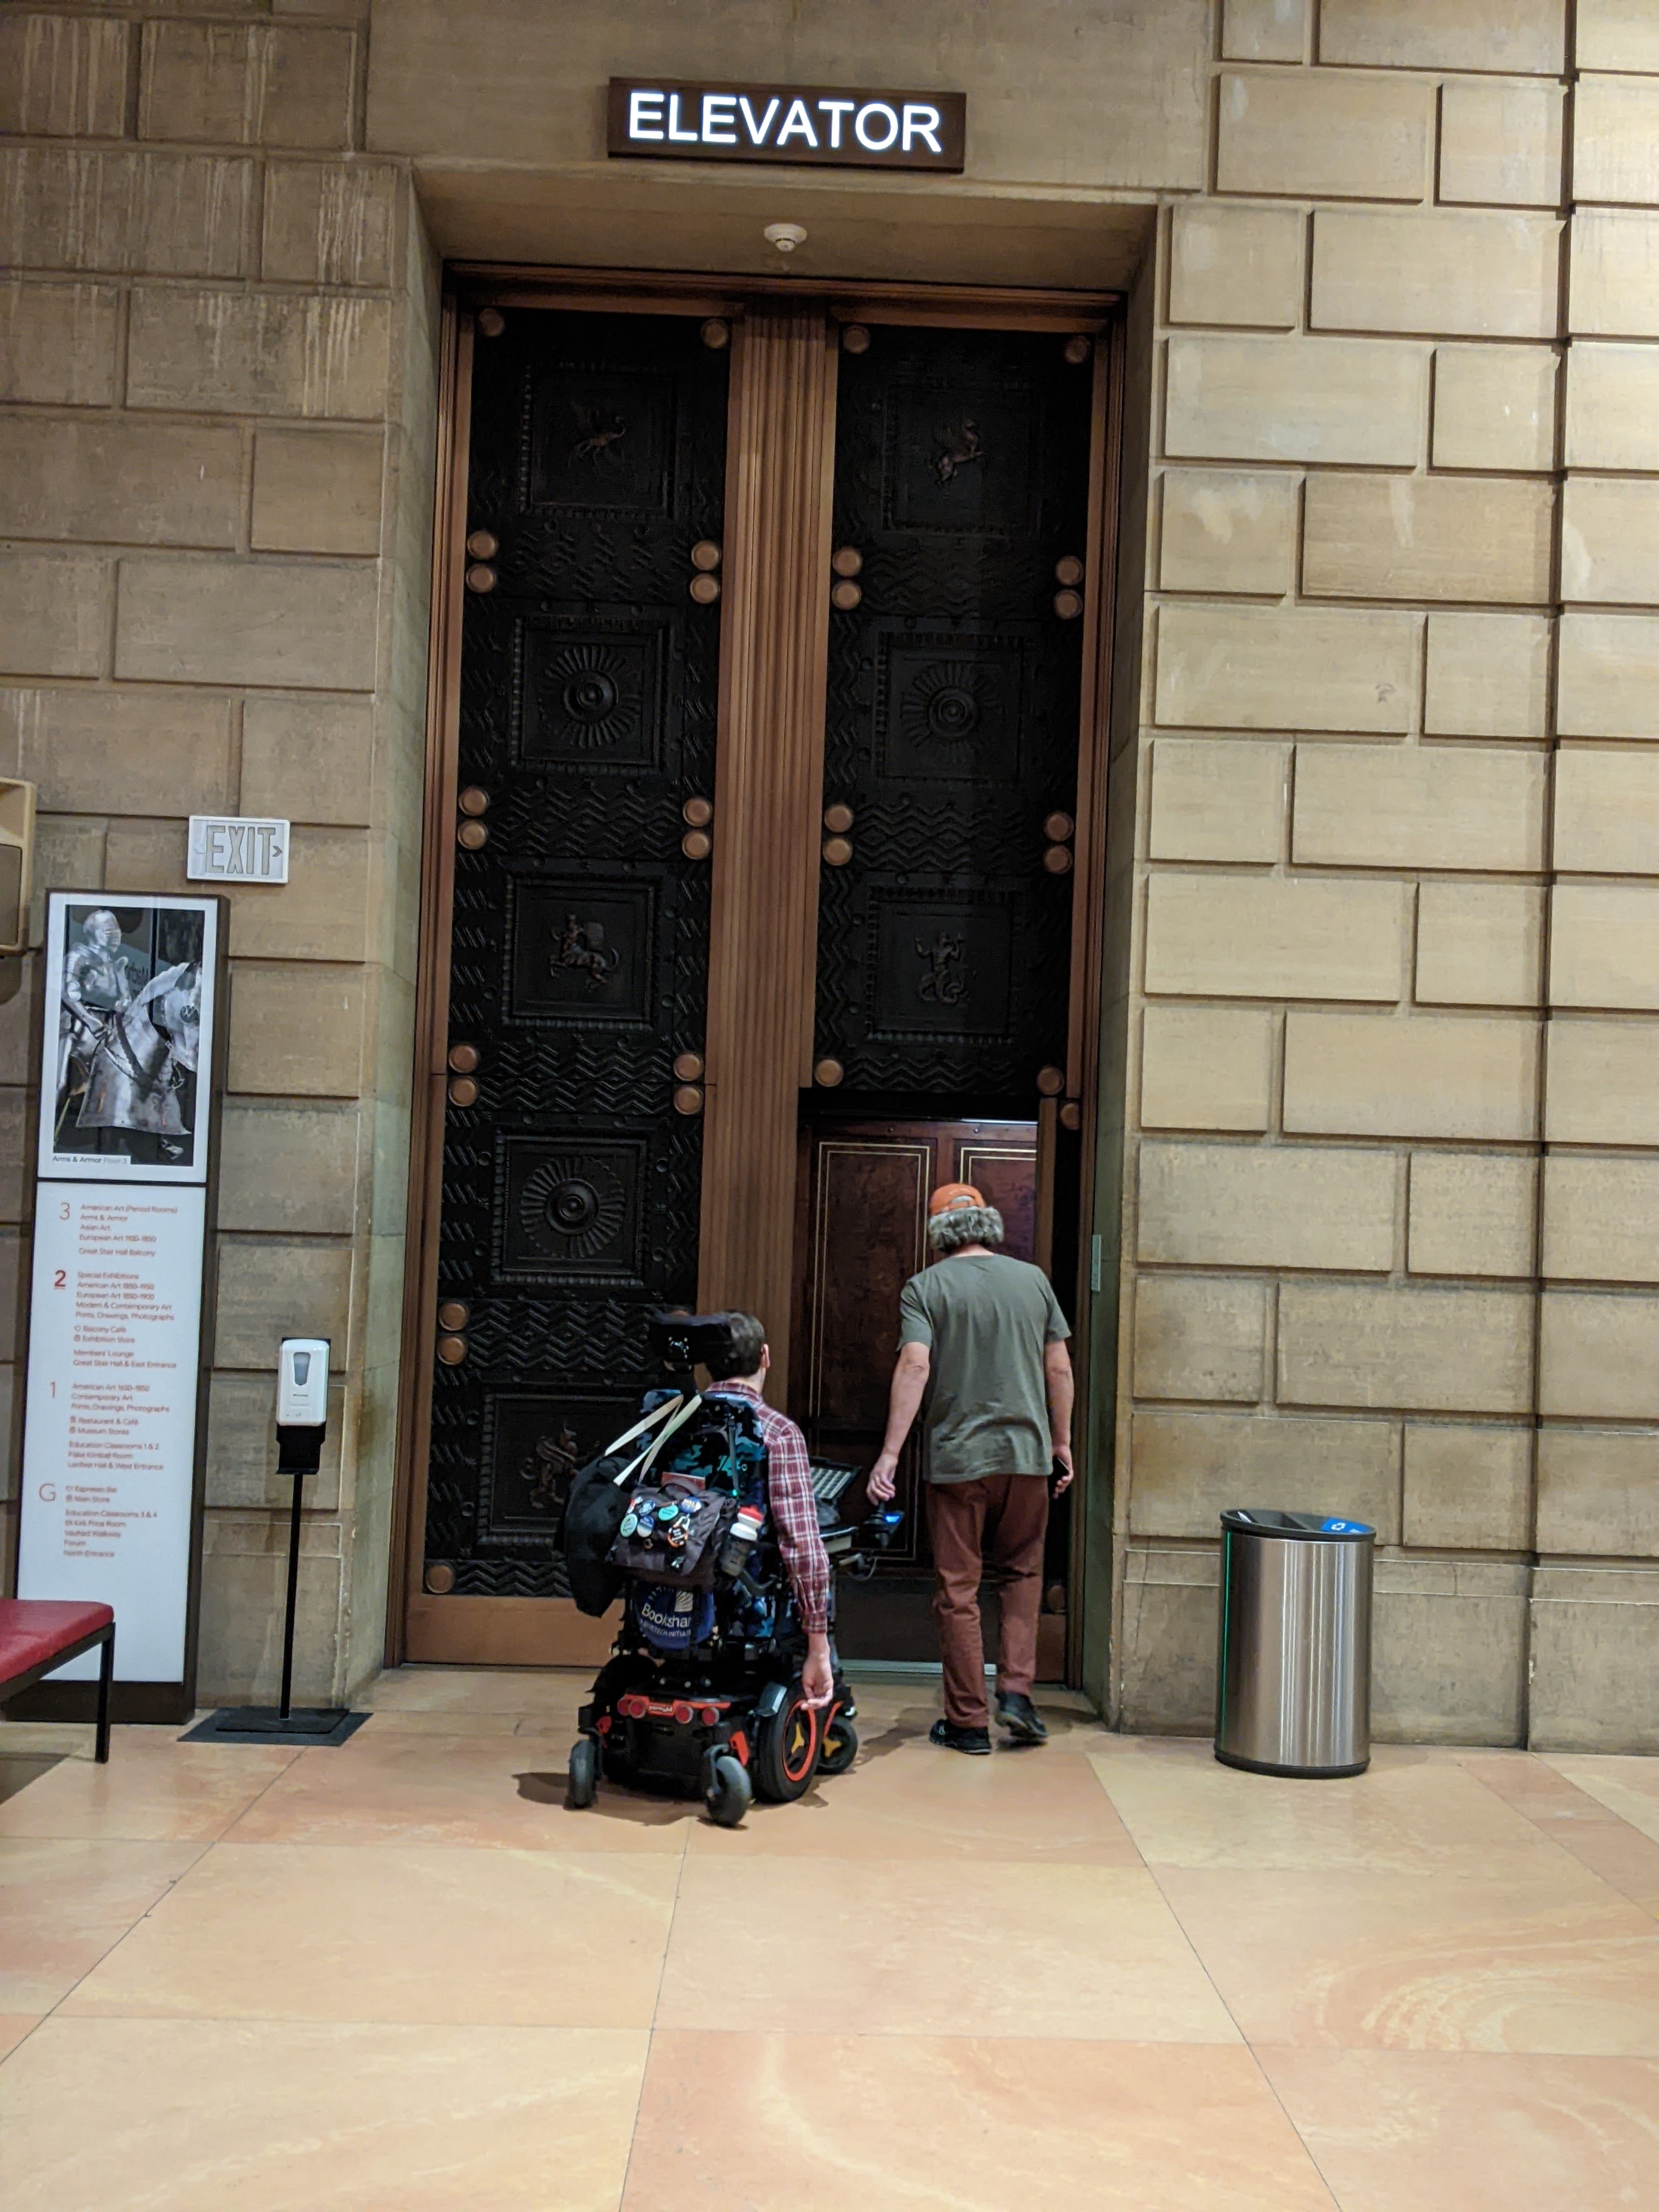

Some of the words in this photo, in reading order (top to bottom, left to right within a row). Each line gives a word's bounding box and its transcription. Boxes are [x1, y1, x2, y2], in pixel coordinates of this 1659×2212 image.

[628, 89, 943, 153] ELEVATOR
[206, 825, 276, 875] EXIT
[53, 1155, 71, 1164] Arms
[59, 1203, 70, 1220] 3
[55, 1270, 66, 1287] 2
[111, 1302, 160, 1311] Contemporary
[131, 1313, 174, 1322] Photographs
[50, 1381, 55, 1398] 1
[126, 1405, 170, 1413] Photographs
[39, 1483, 55, 1501] G
[641, 1602, 691, 1628] Bookshar
